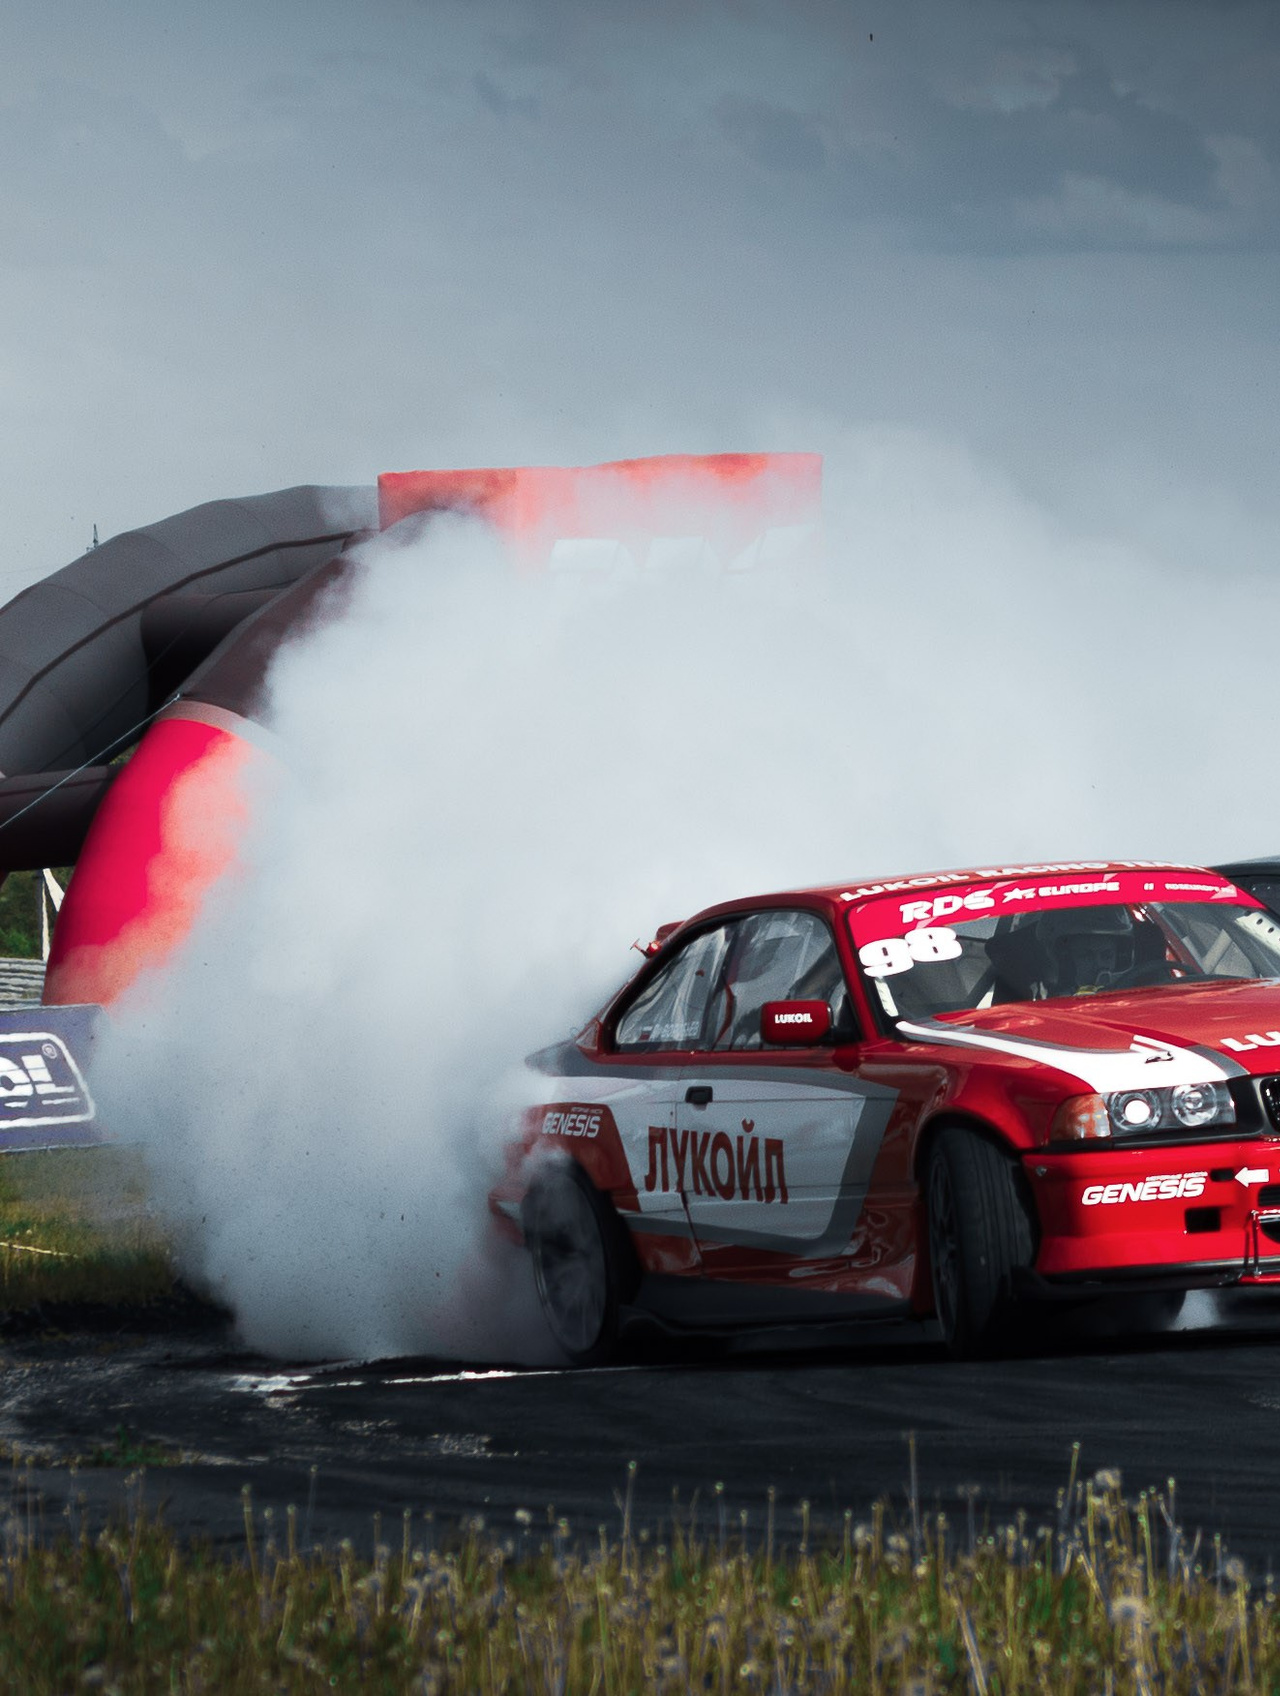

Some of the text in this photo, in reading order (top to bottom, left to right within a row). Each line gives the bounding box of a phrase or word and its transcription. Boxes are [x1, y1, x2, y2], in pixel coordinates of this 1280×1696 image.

[839, 873, 970, 902] LUKOIL
[899, 881, 1120, 924] RDS EUROPE
[858, 926, 963, 978] 98
[774, 1012, 813, 1024] LUKOIL
[541, 1111, 601, 1138] GENESIS
[644, 1118, 789, 1205] ЛУКОЙЛ
[1081, 1176, 1207, 1206] GENESIS
